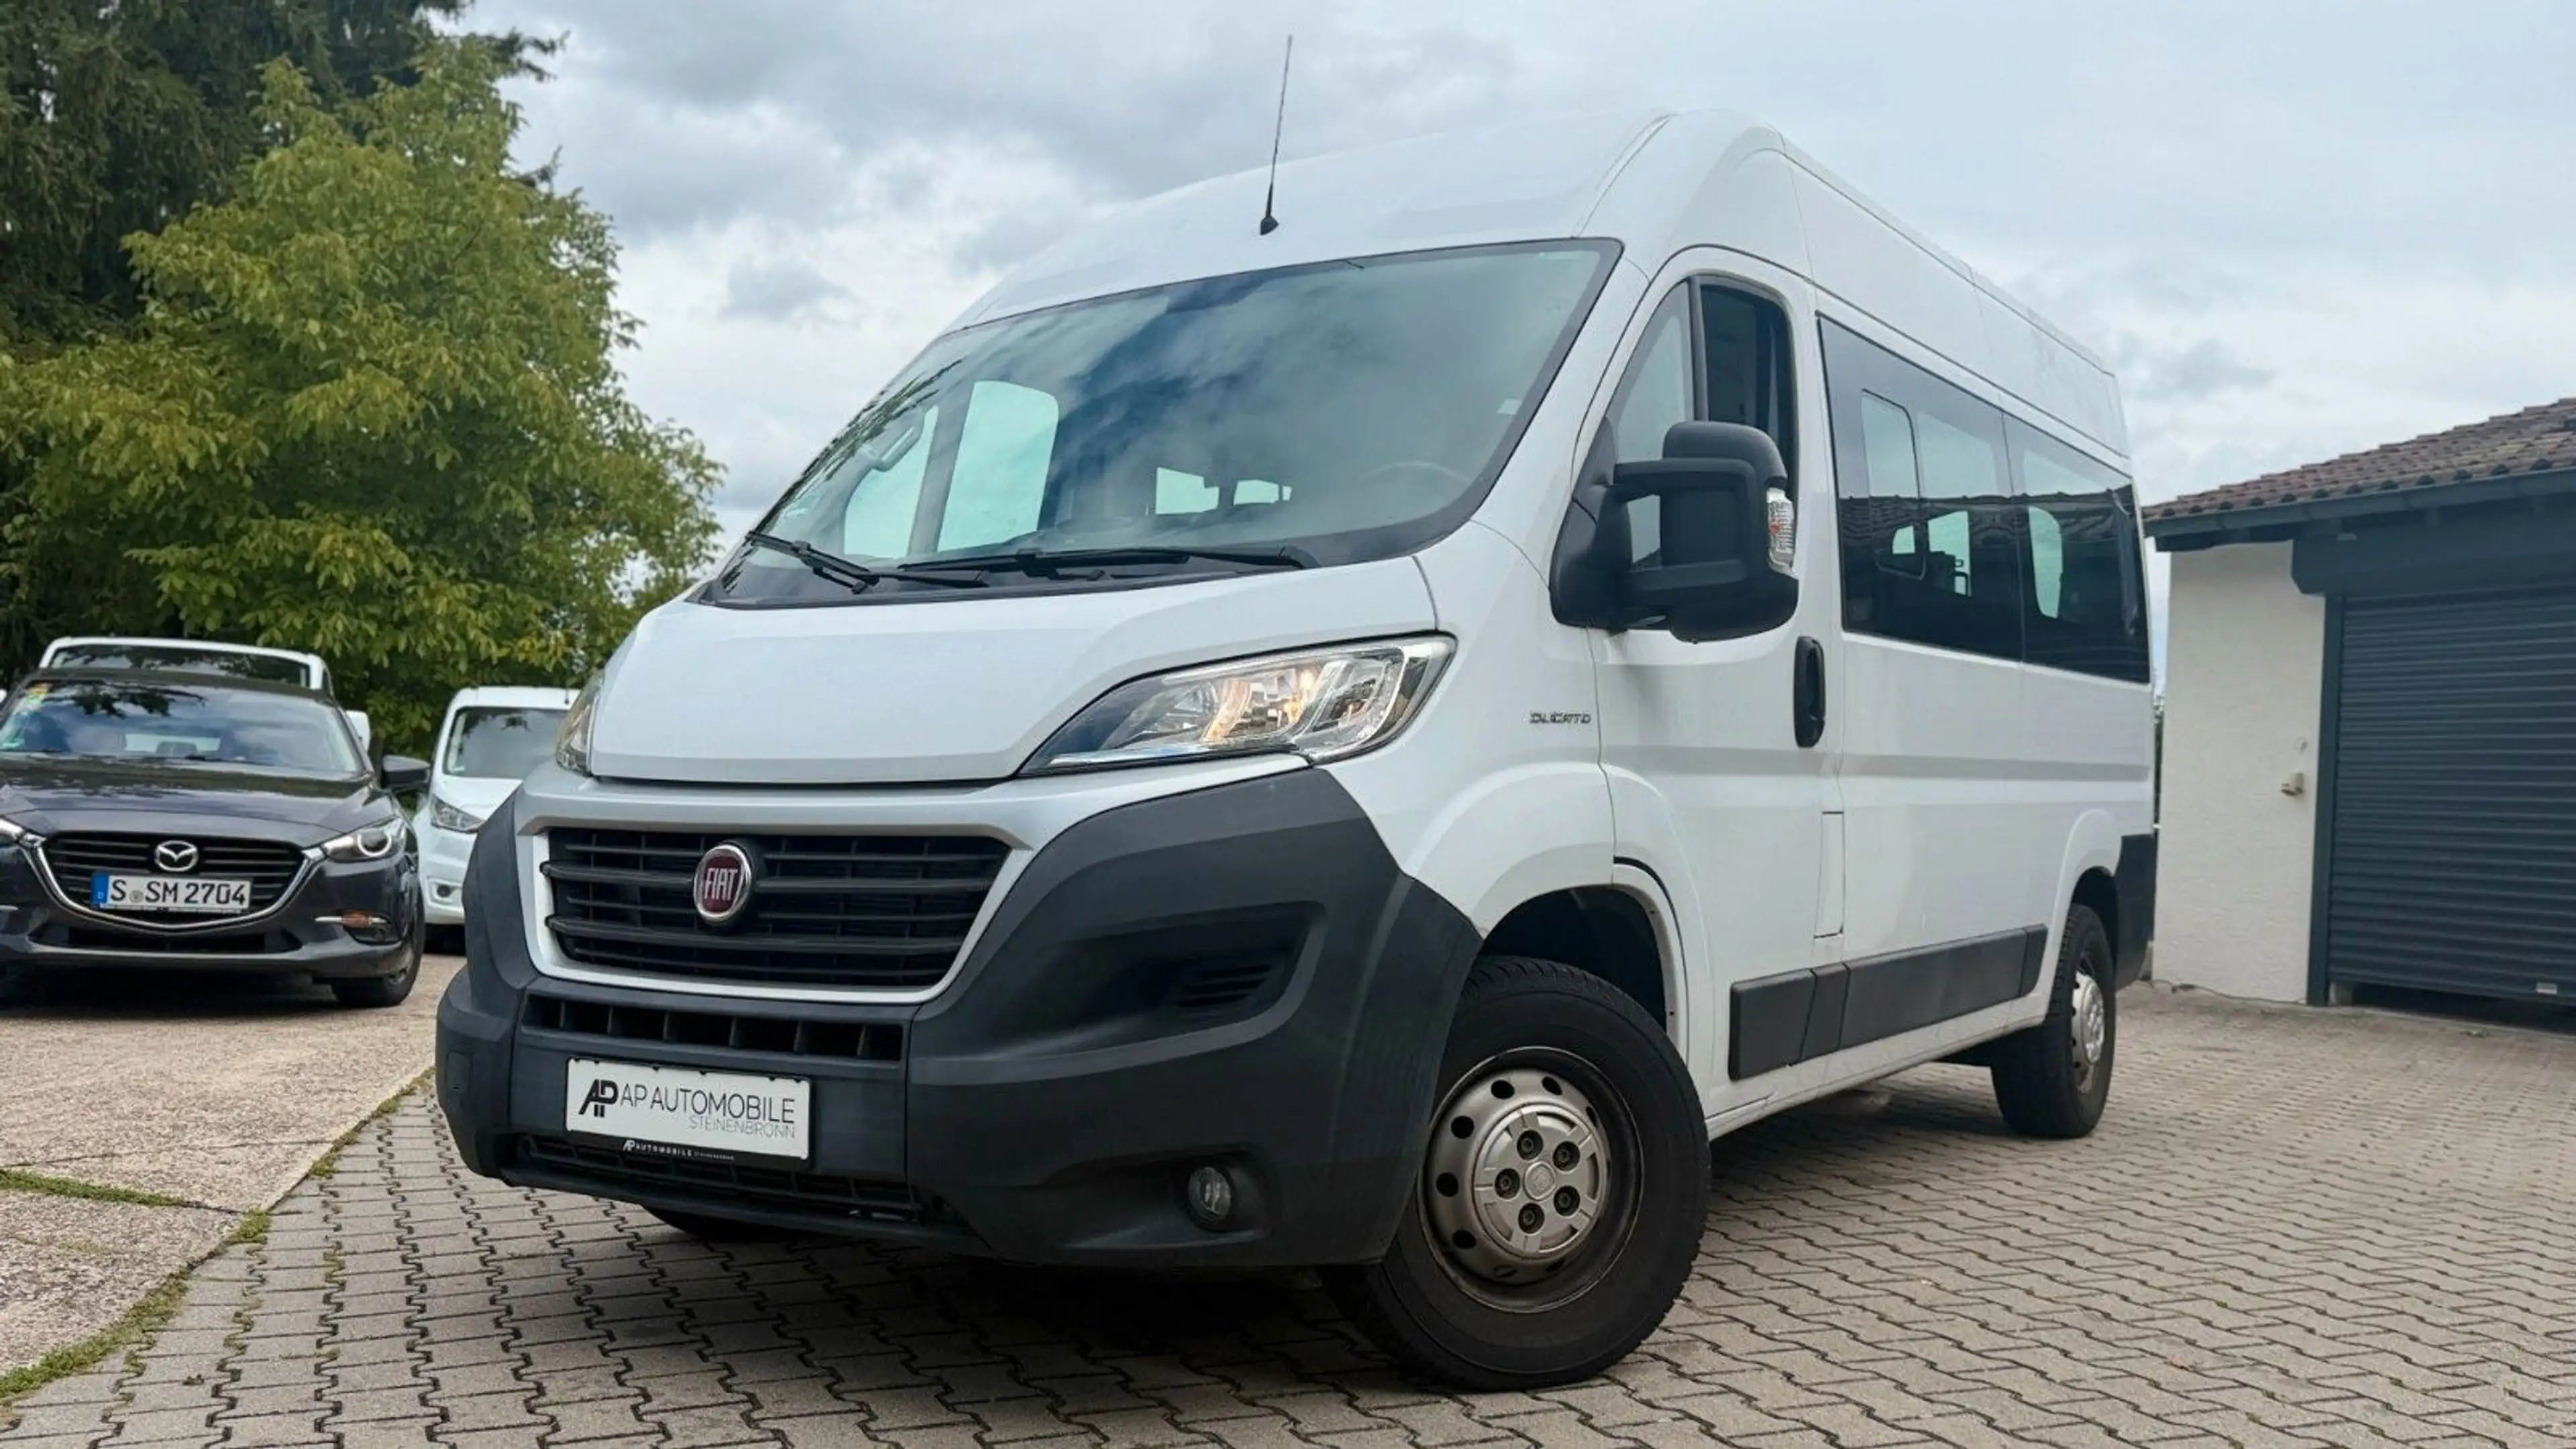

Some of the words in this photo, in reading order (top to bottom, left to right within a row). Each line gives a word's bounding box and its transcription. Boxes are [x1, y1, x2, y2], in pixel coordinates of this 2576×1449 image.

[1529, 712, 1591, 724] DUCATO
[111, 879, 127, 901] S
[145, 881, 178, 903] SM
[184, 882, 246, 905] 2704
[704, 867, 738, 901] FIAT
[620, 1083, 647, 1109] AP
[650, 1086, 795, 1124] AUTOMOBILE
[688, 1114, 795, 1139] STEINENBRONN
